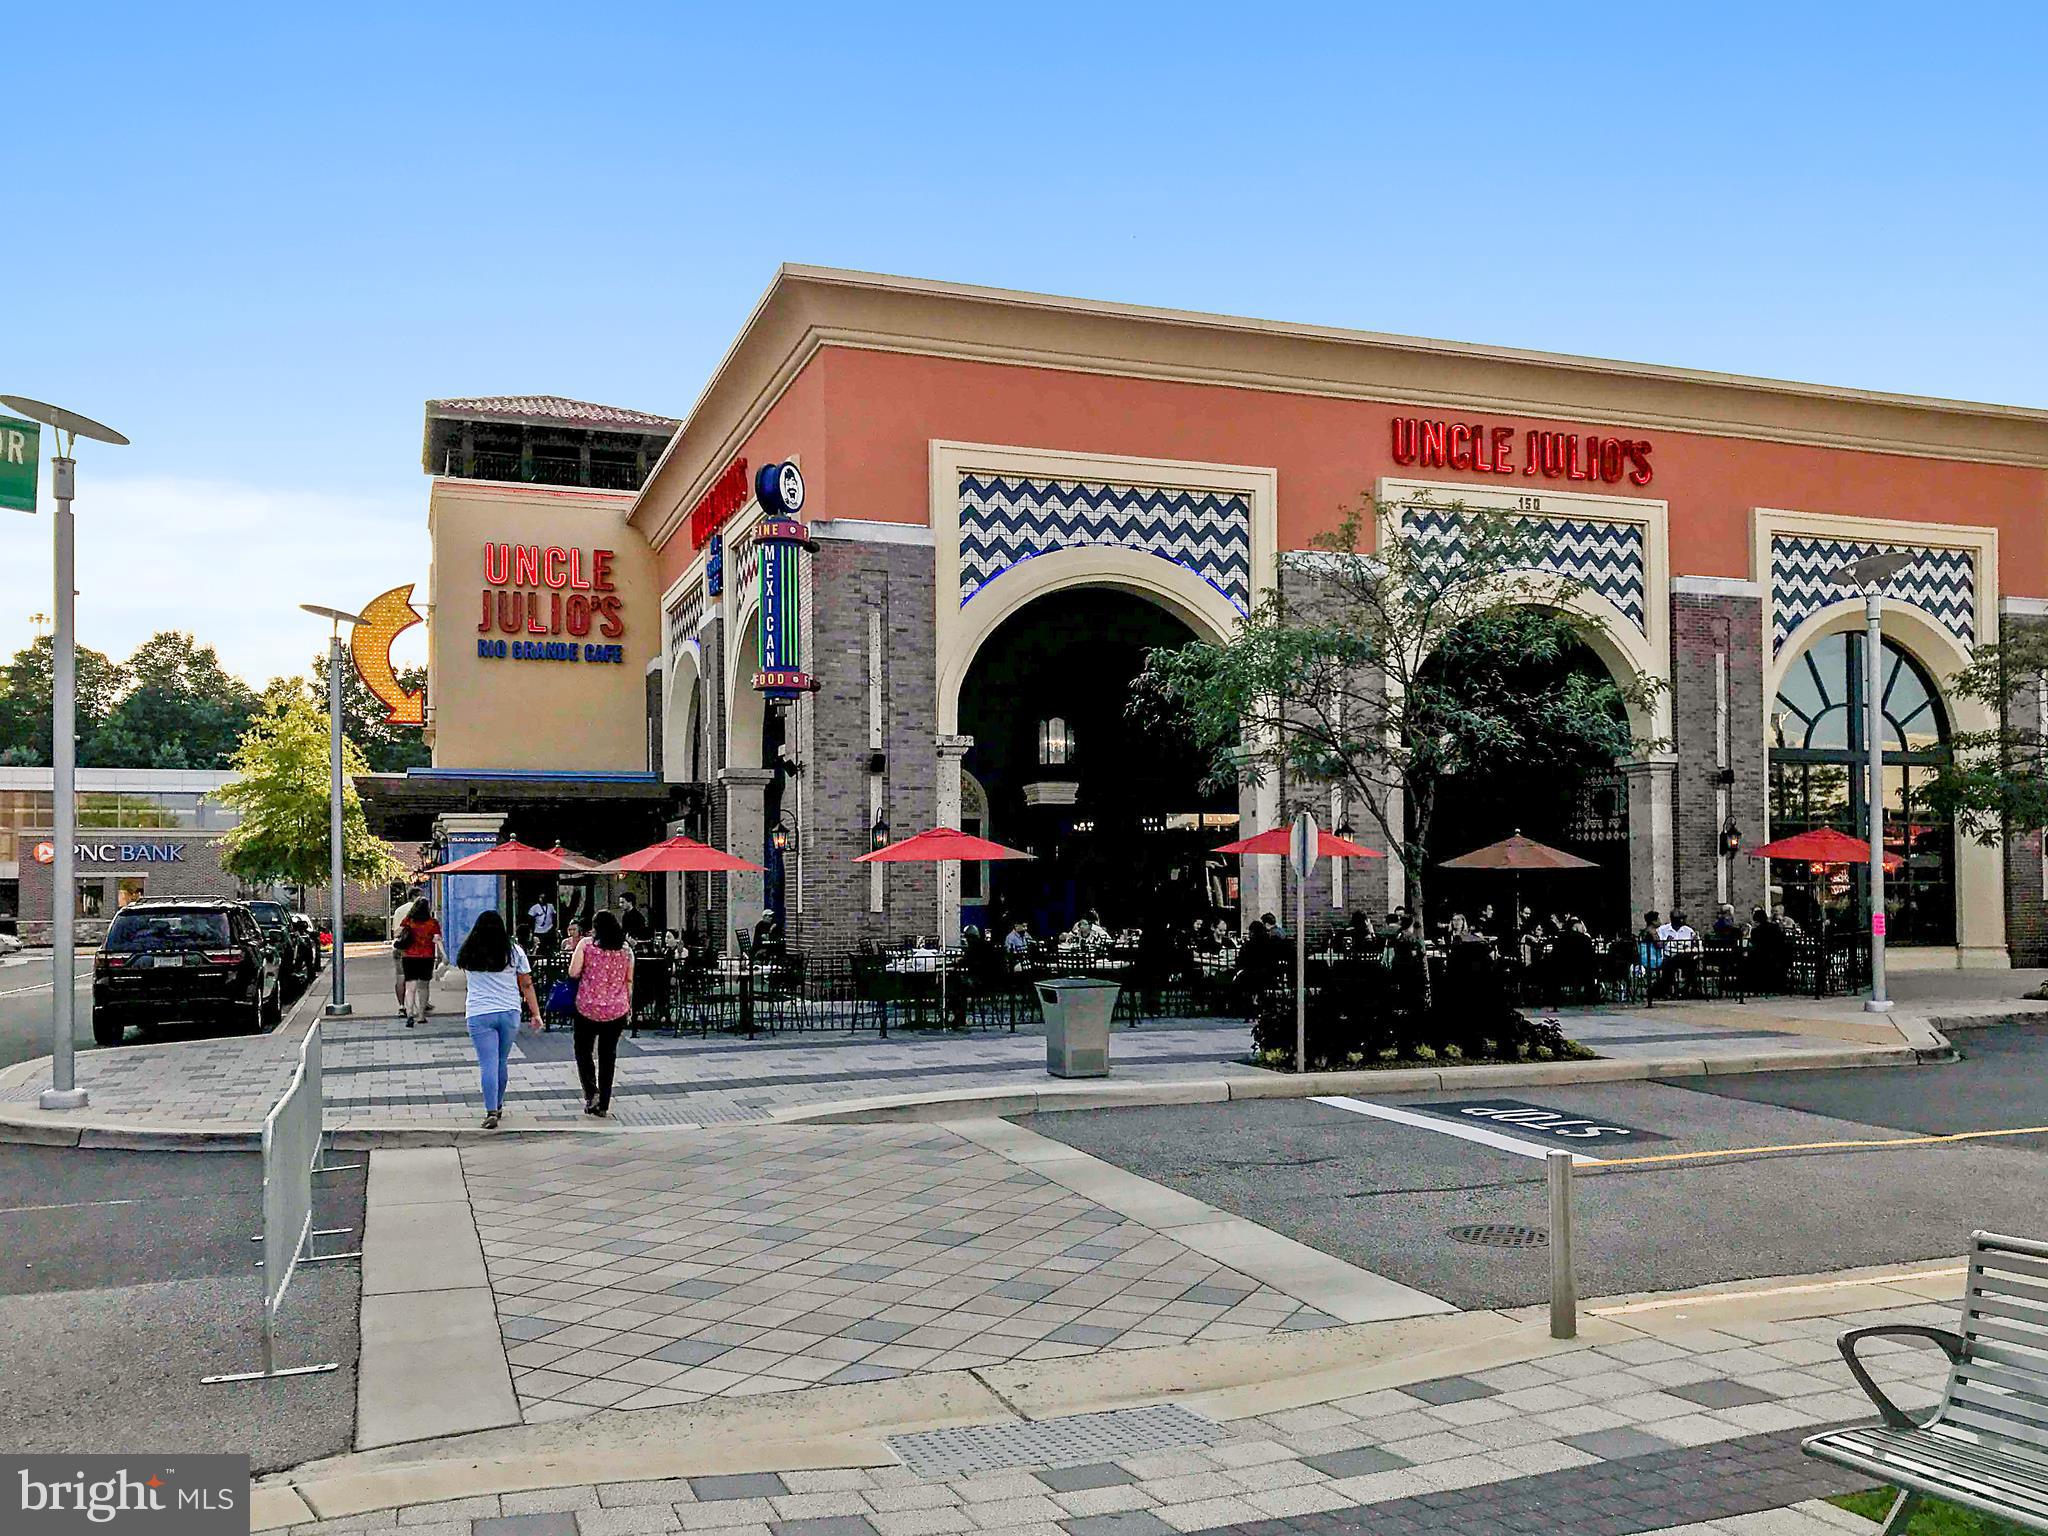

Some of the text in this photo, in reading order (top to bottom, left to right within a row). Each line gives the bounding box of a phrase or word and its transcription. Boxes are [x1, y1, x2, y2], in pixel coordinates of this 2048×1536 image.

[0, 430, 24, 464] R
[1391, 417, 1653, 487] UNCLE JULIO'S
[1518, 497, 1540, 511] 150
[753, 523, 779, 537] FINE
[485, 542, 615, 591] UNCLE
[477, 589, 625, 638] JULIO'S
[764, 544, 776, 667] MEXICAN
[477, 639, 623, 663] RIO GRANDE CAFE
[753, 673, 784, 686] FOOD
[121, 844, 186, 862] BANK
[1460, 1108, 1631, 1138] STOP
